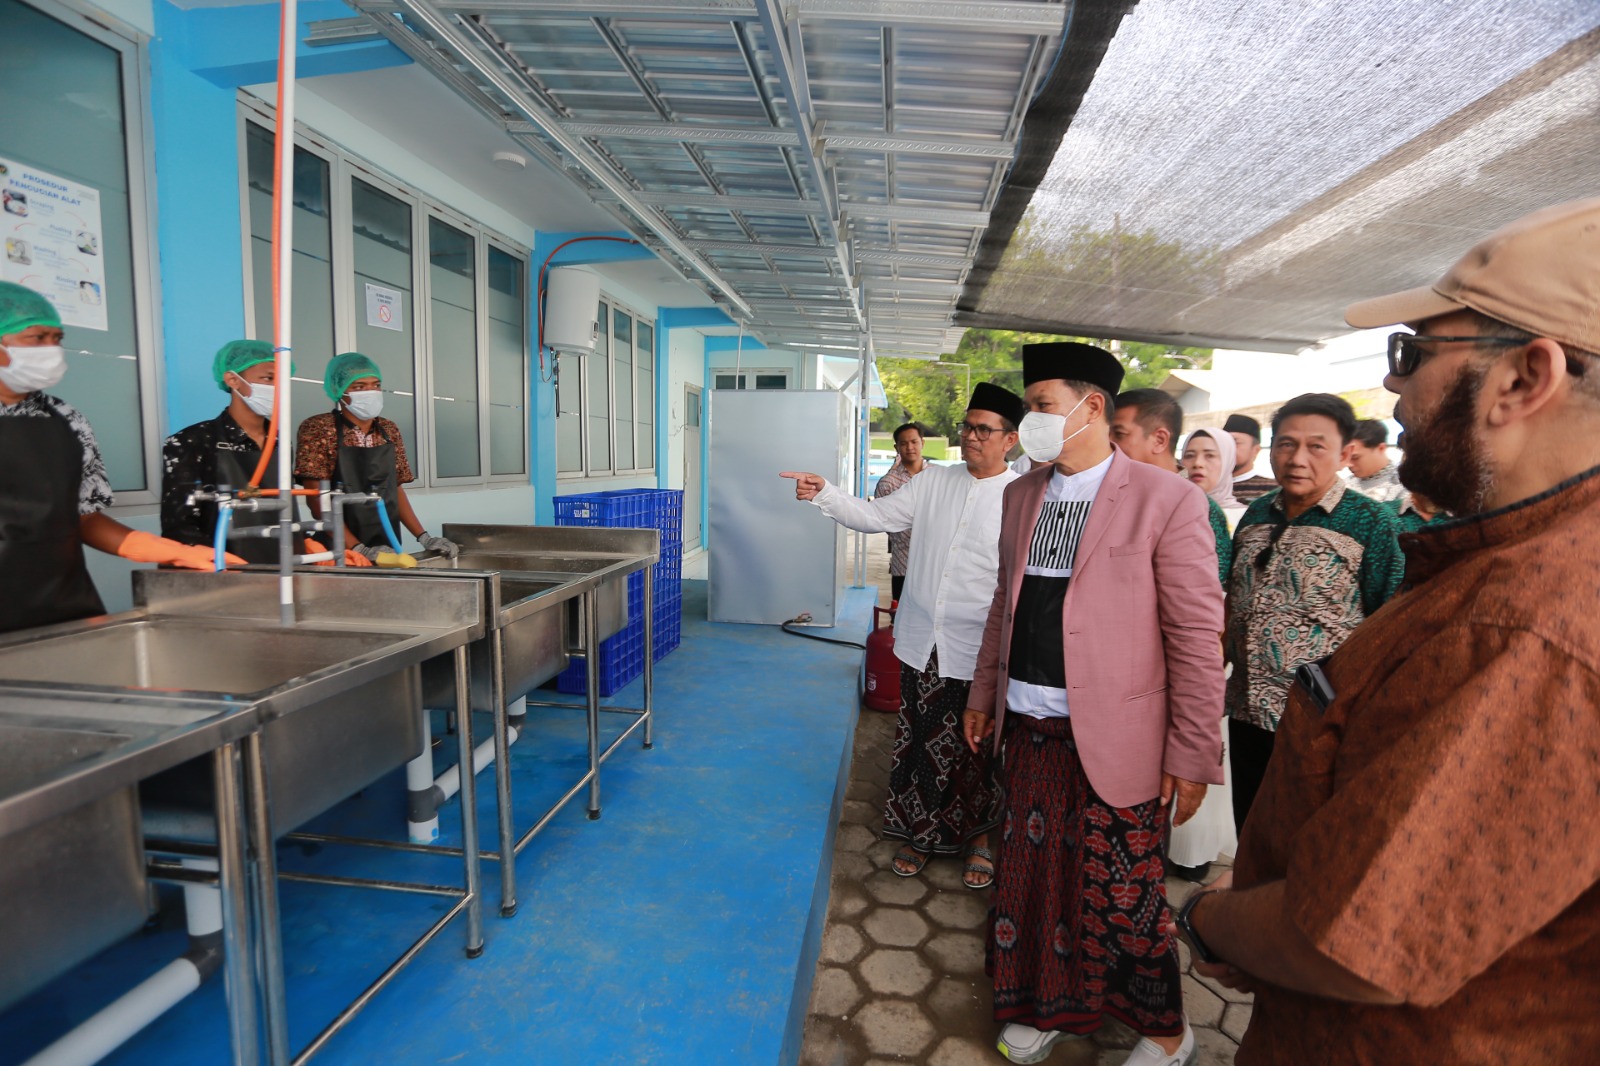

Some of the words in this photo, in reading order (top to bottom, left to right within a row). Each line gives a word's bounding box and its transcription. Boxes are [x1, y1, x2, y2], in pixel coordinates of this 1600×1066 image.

[9, 179, 59, 198] PENCUCIAN
[61, 196, 81, 206] ALAT
[23, 173, 68, 192] PROSEDUR
